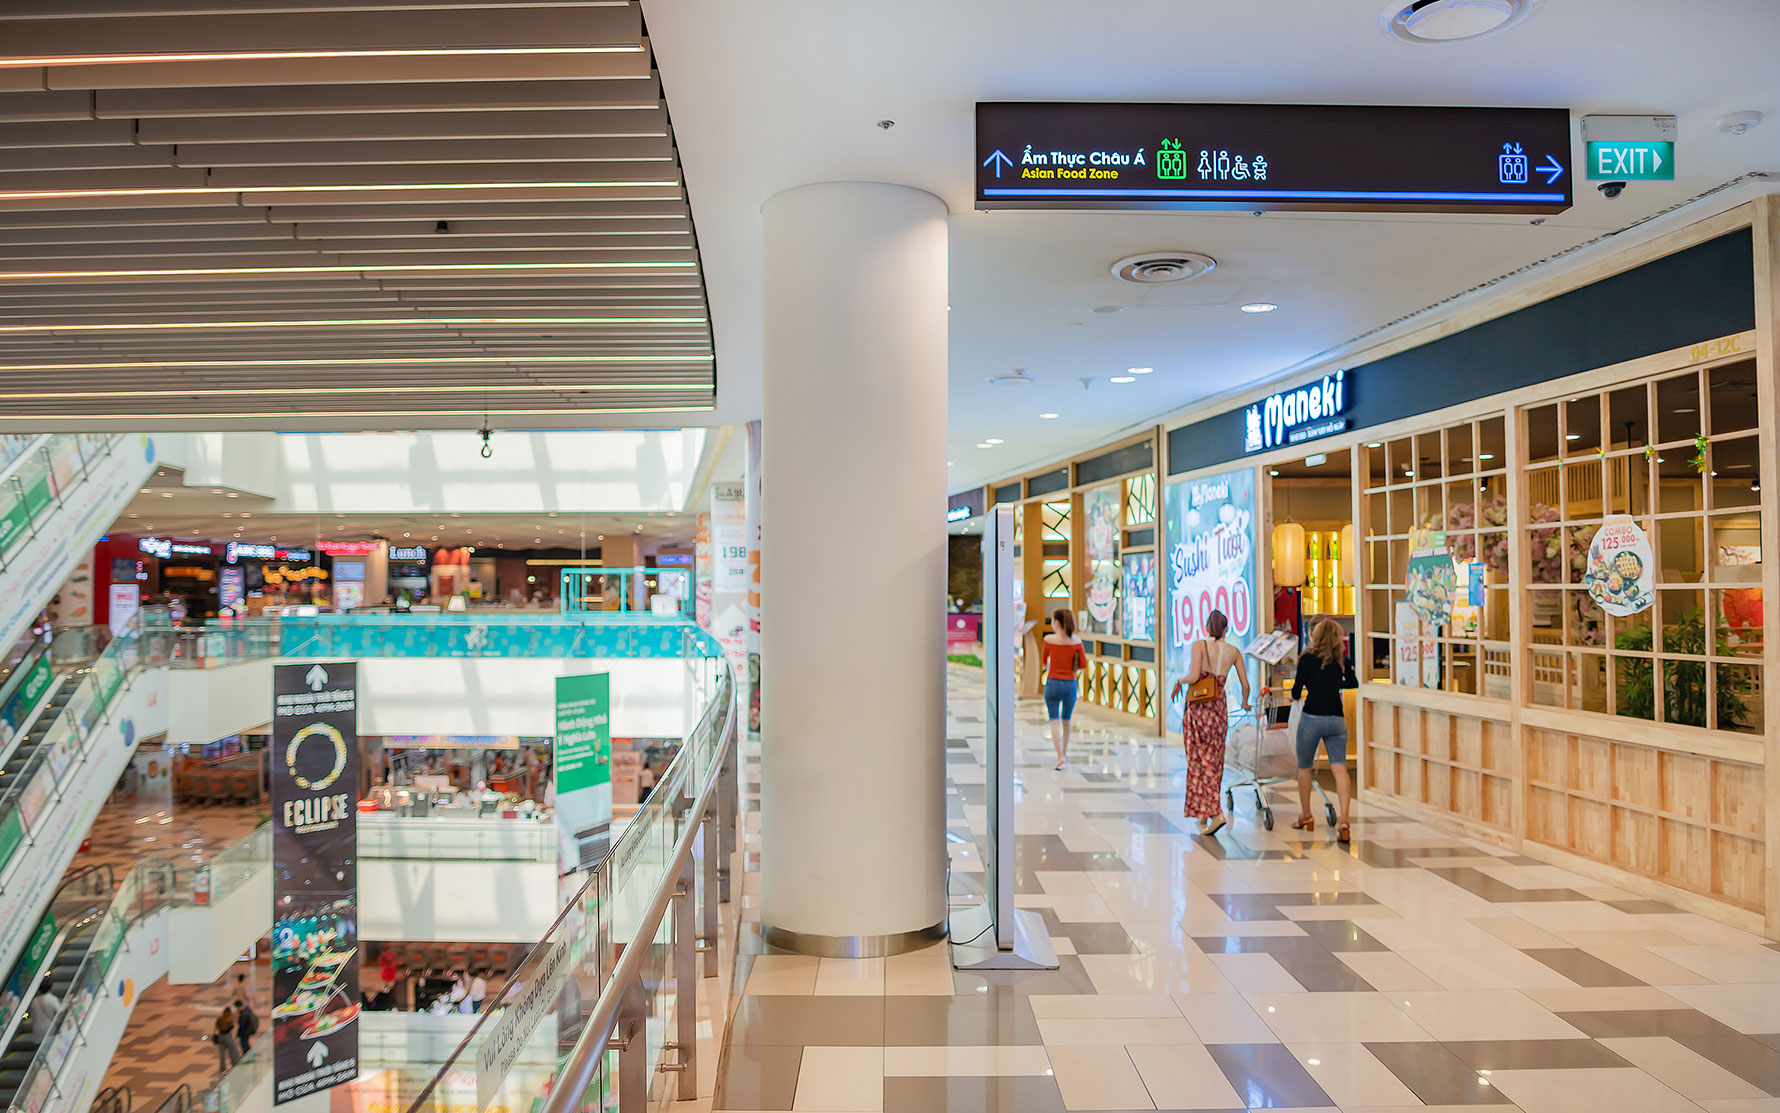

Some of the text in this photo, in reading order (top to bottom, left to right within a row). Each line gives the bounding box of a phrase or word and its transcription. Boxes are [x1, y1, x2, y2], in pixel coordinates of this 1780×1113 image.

[1021, 144, 1146, 168] Ẩm Thực Châu Á
[1599, 148, 1648, 174] EXIT
[1021, 168, 1119, 179] Asian Food Zone
[1690, 335, 1740, 361] 04-12C
[1264, 369, 1344, 448] Maneki
[1604, 526, 1632, 536] COMBO
[1175, 535, 1209, 583] Sushi
[284, 793, 349, 828] ECLIPSE
[484, 1040, 497, 1072] Vui
[500, 1047, 516, 1078] Please
